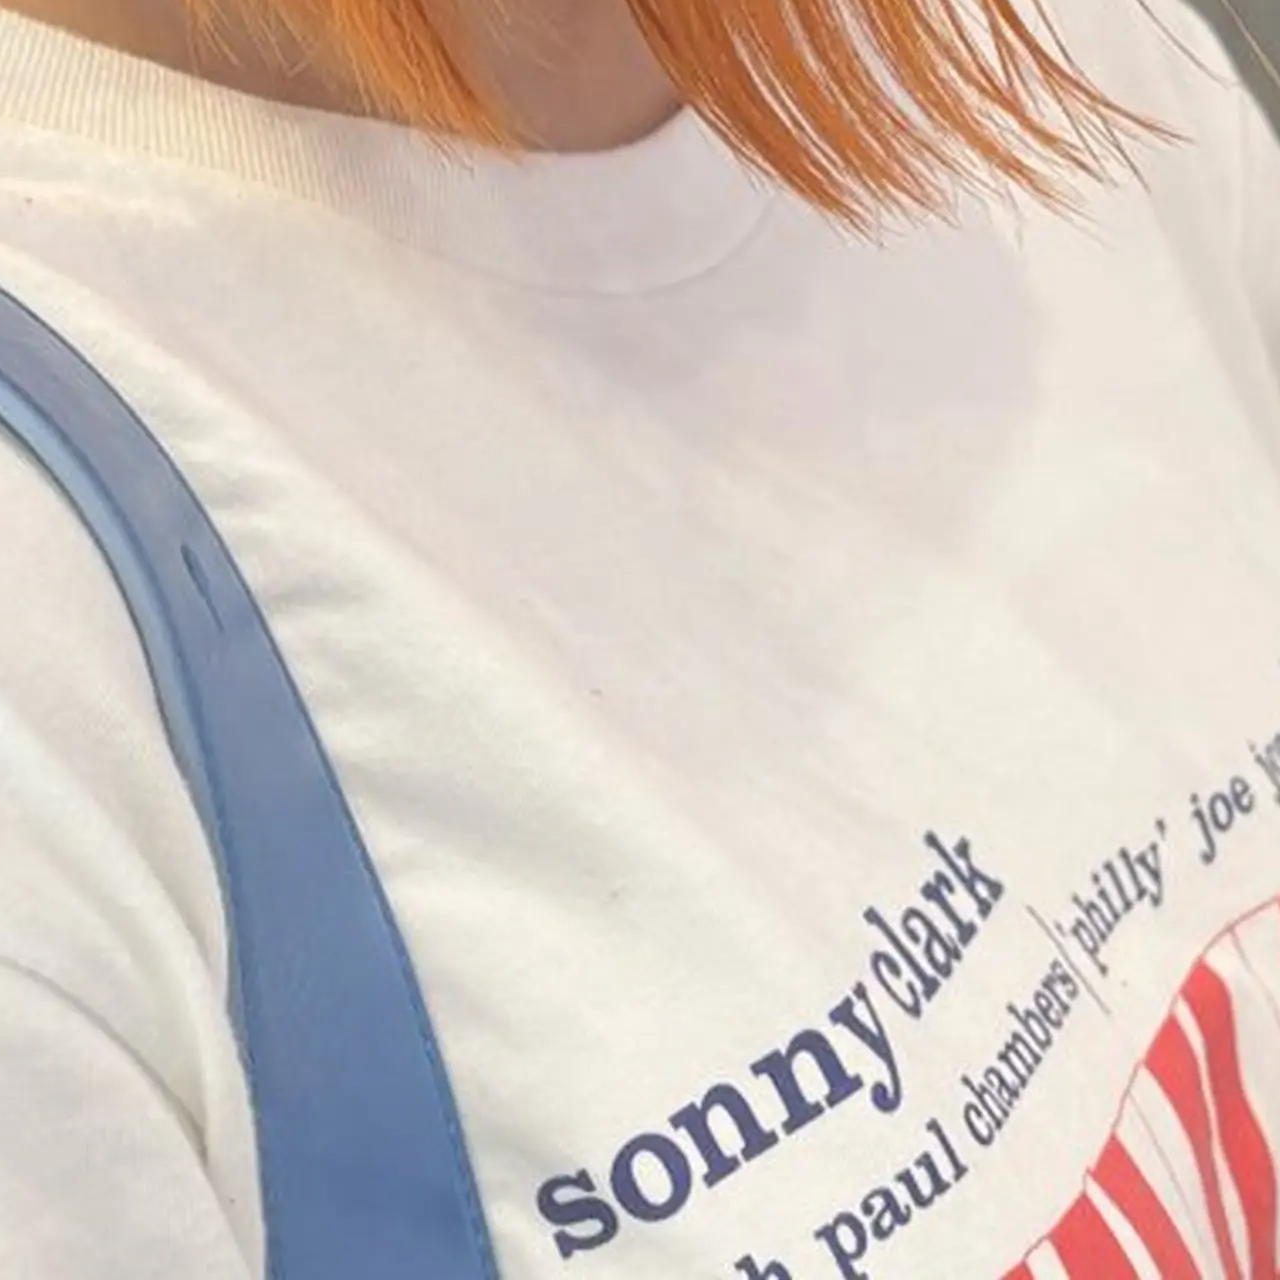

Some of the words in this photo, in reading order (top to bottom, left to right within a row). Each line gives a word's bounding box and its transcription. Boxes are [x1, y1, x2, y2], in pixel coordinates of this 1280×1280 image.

[536, 981, 903, 1260] sonny
[863, 829, 1005, 1019] clark
[814, 1117, 969, 1280] paul
[962, 957, 1080, 1147] chambers
[1190, 773, 1255, 865] joe
